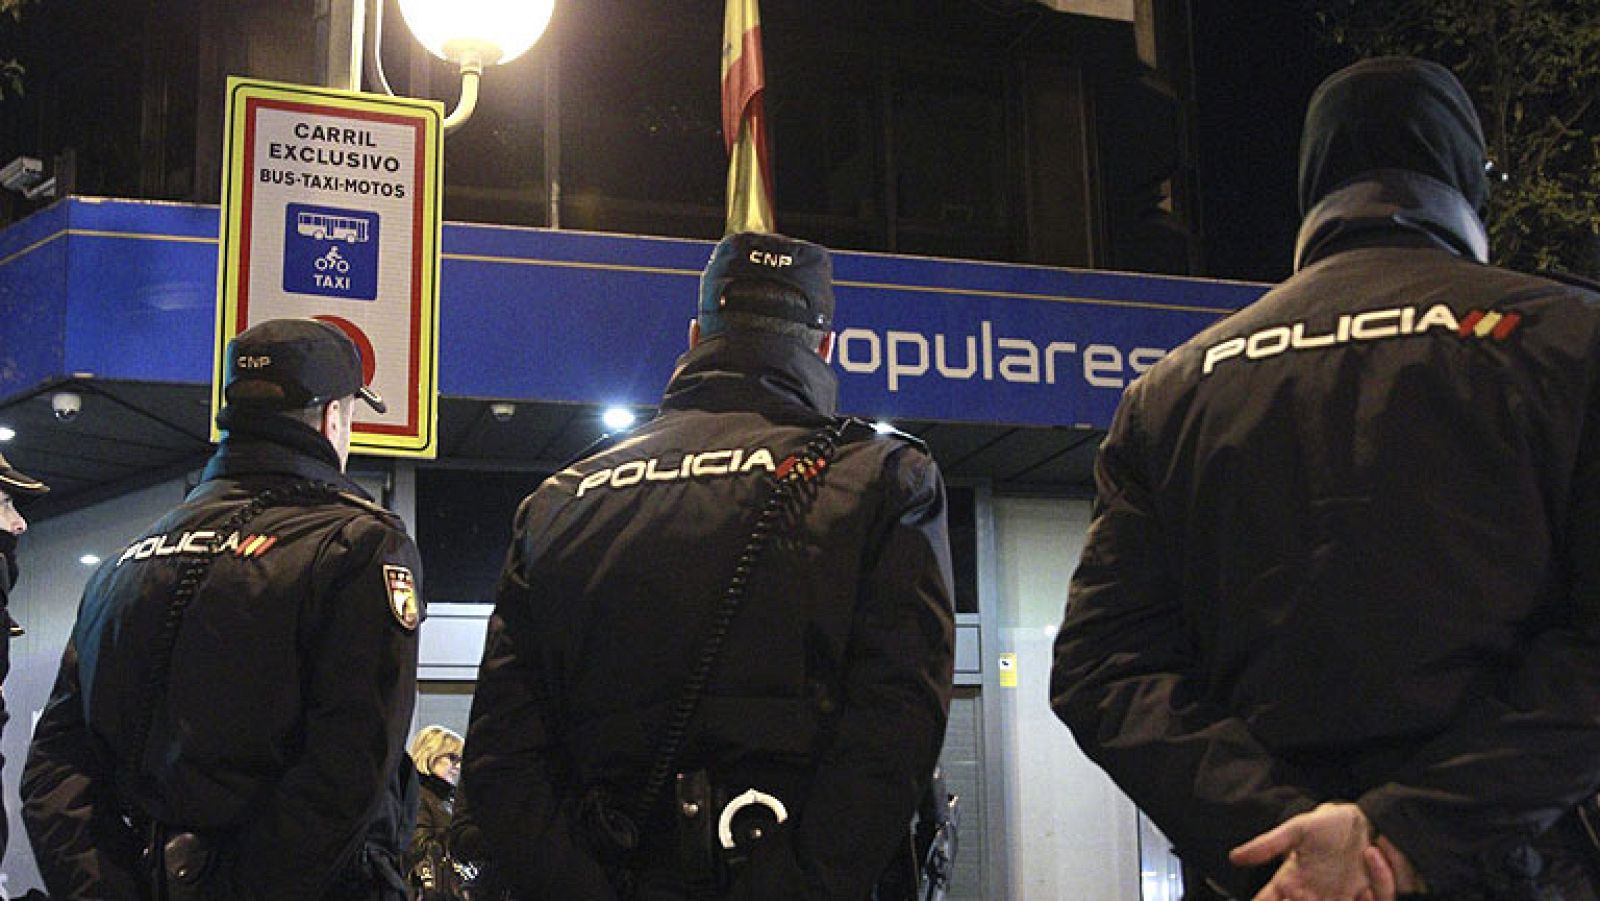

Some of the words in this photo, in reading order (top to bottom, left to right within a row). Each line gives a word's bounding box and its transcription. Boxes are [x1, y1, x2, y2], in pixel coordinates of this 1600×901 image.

[294, 122, 377, 147] CARRIL
[269, 143, 399, 172] EXCLUSIVO
[259, 168, 405, 198] BUS-TAXI-MOTOS
[749, 250, 793, 268] CNP
[314, 274, 351, 290] TAXI
[1202, 304, 1460, 375] POLICIA
[237, 355, 271, 368] CNP
[837, 320, 1167, 393] opulares
[576, 448, 776, 497] POLICIA
[116, 531, 240, 568] POLICA
